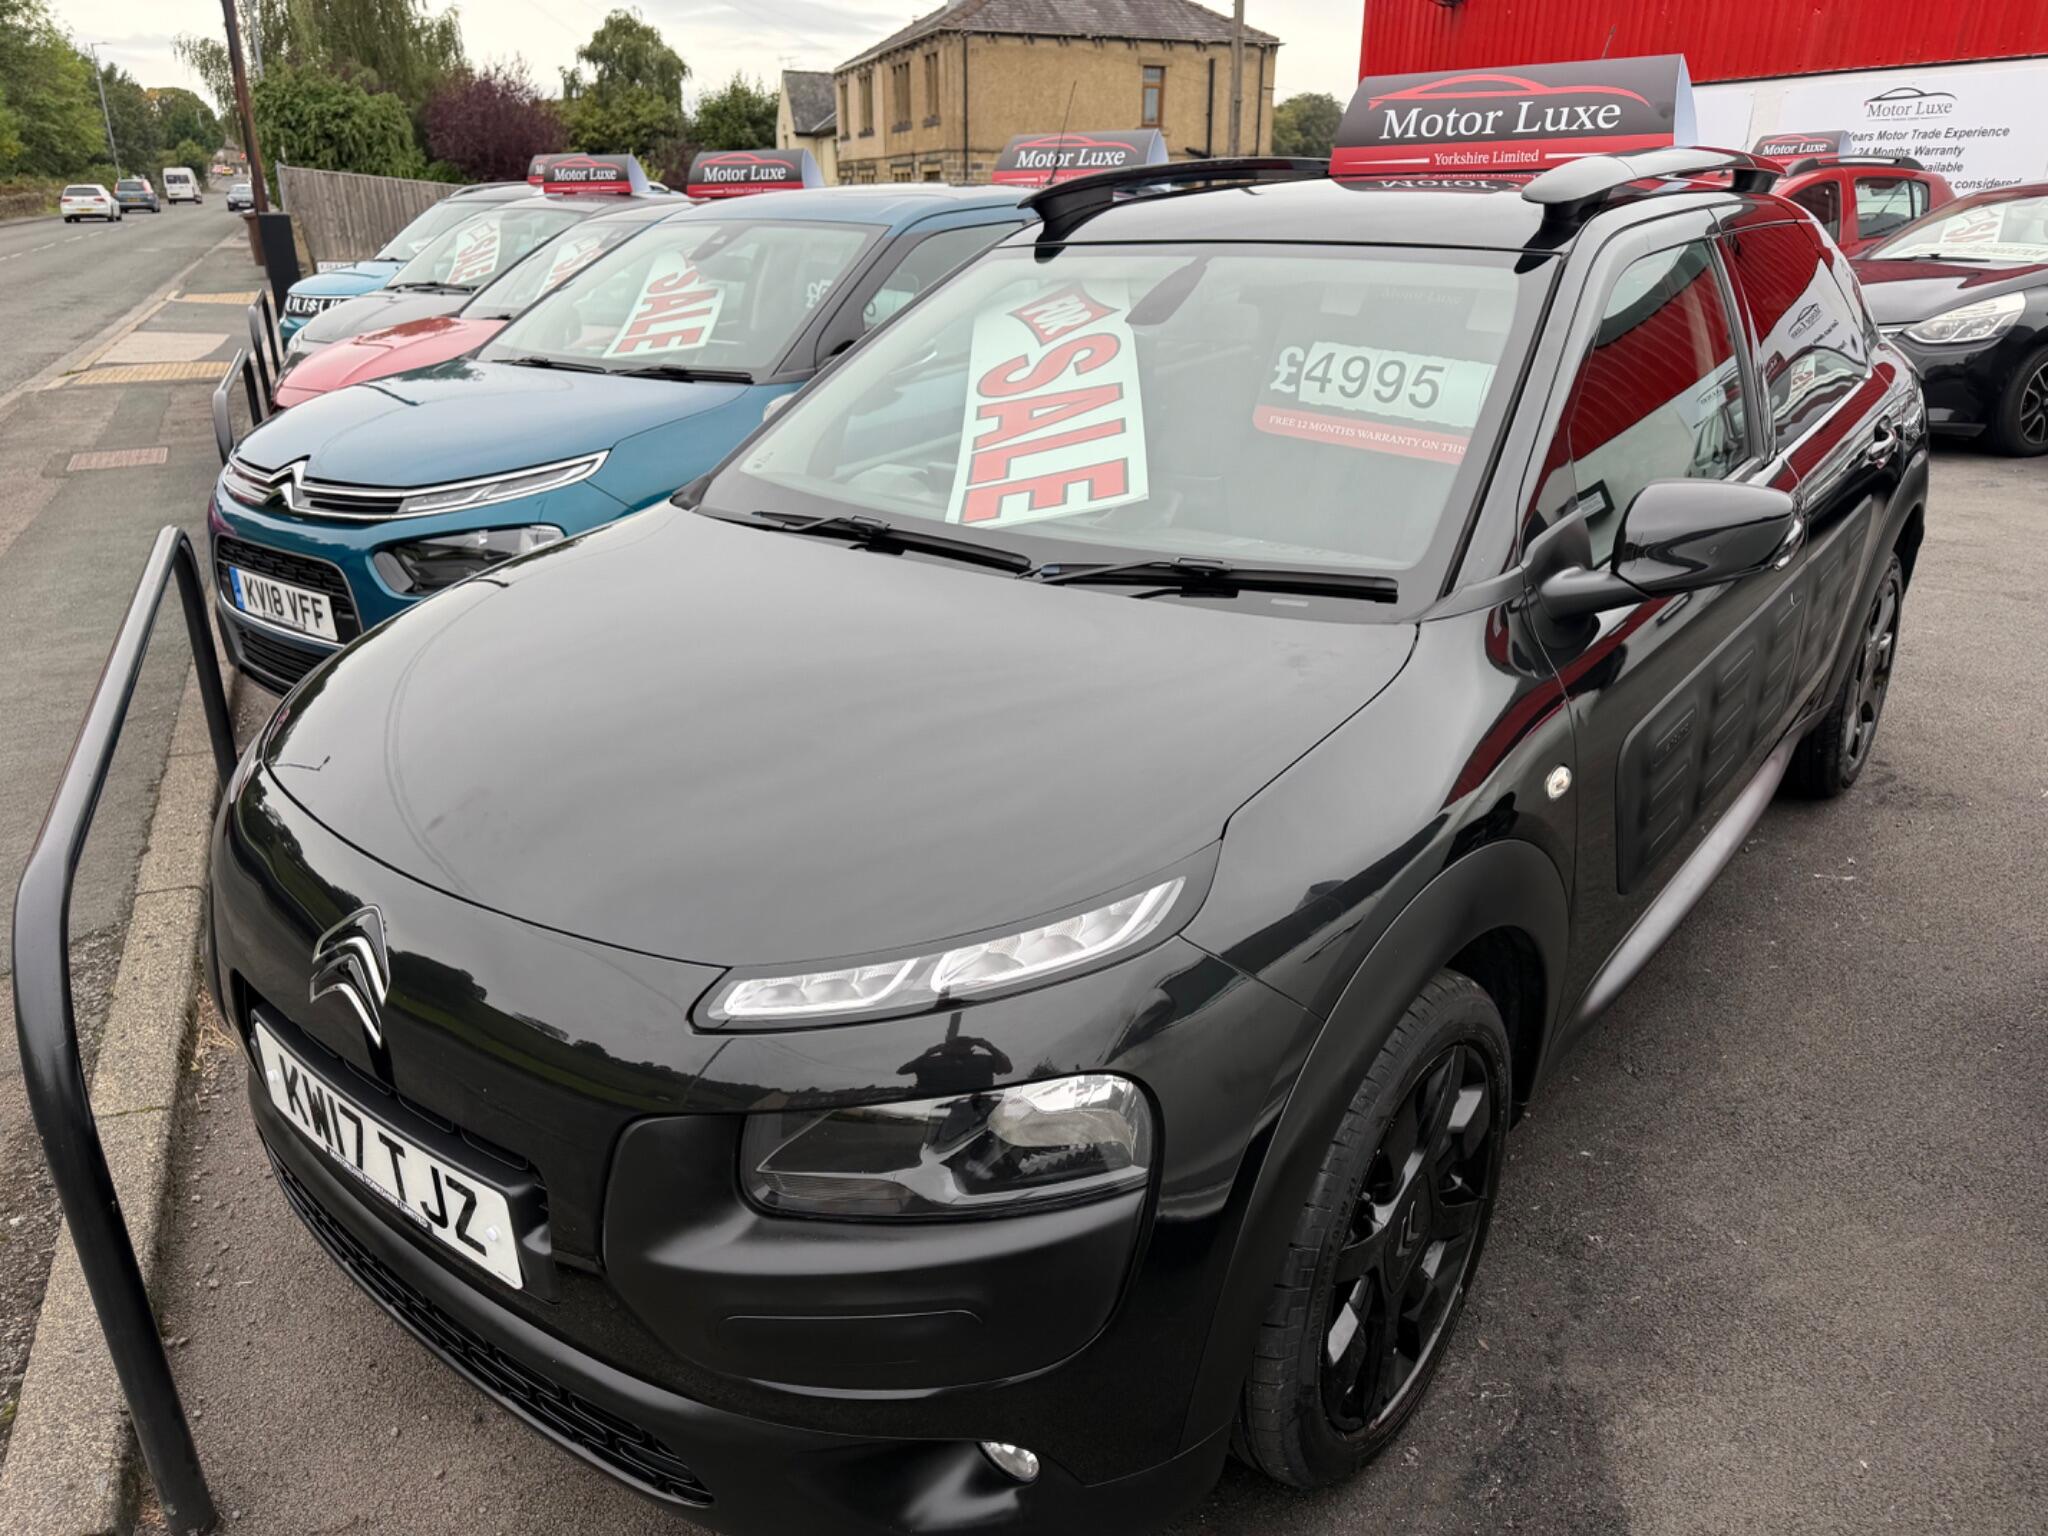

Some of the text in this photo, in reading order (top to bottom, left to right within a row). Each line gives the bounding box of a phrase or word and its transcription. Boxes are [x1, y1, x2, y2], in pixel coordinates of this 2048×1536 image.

[1867, 101, 1953, 118] Motor Luxe
[1379, 100, 1621, 139] Motor Luxe
[1877, 130, 1909, 141] Motor
[1911, 128, 1942, 140] Trade
[1944, 126, 2010, 140] Experience
[1434, 149, 1540, 166] Yorkshire Limited
[1762, 142, 1828, 155] Motor Luxe
[1914, 145, 1965, 158] Warranty
[1015, 149, 1126, 168] Motor Luxe
[554, 168, 588, 181] Motor
[589, 167, 617, 180] Luxe
[703, 165, 787, 182] Motor Luxe
[612, 270, 719, 354] SALE
[1269, 345, 1446, 410] £4995
[961, 294, 1129, 524] FOR SALE
[1269, 415, 1296, 428] FREE
[1297, 420, 1308, 429] 12
[1309, 422, 1355, 438] MONTHS
[1357, 428, 1421, 448] WARRANTY
[1422, 439, 1439, 450] ON
[243, 575, 284, 617] KV18
[279, 1053, 364, 1170] KW17
[377, 1130, 488, 1257] TJZ
